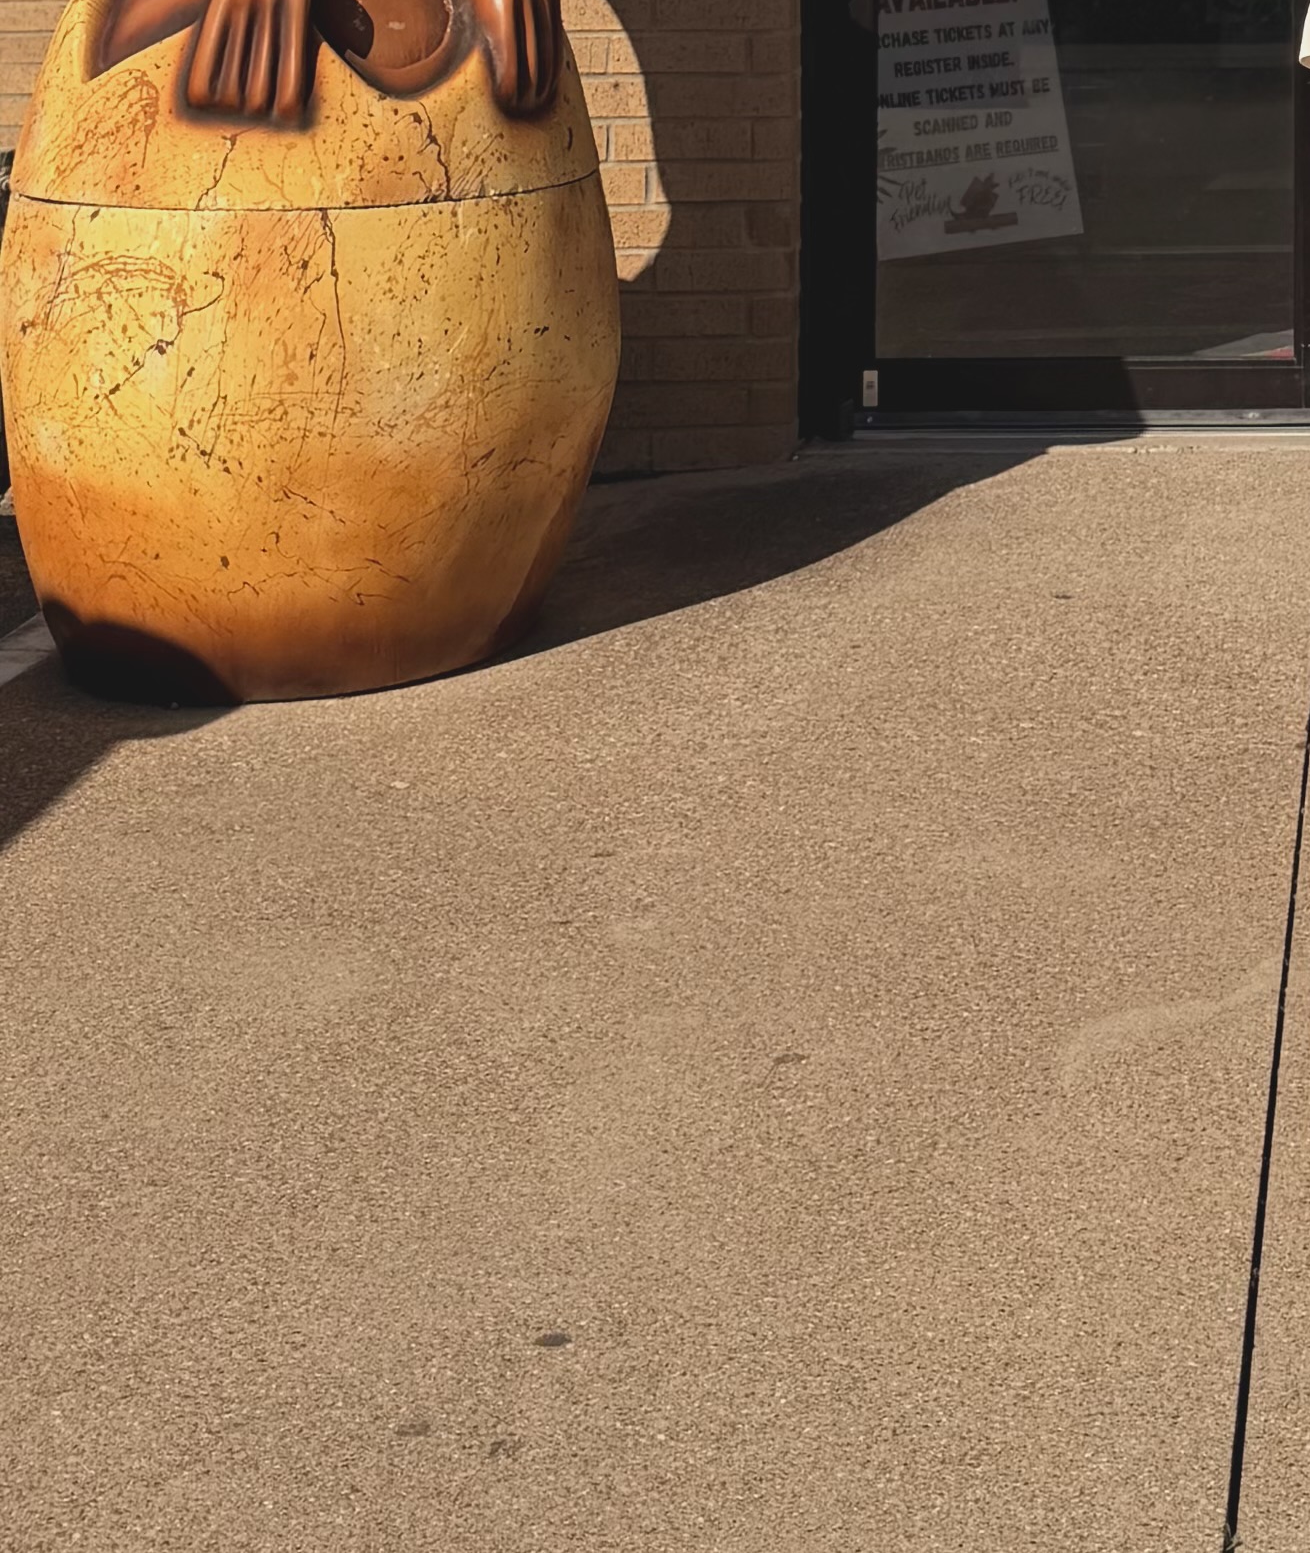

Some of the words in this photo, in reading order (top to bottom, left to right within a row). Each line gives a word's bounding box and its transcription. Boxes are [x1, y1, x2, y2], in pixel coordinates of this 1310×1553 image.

[878, 30, 930, 50] CHASE
[934, 24, 992, 44] TICKETS
[998, 21, 1017, 38] AT
[1022, 19, 1049, 36] ANY
[894, 56, 962, 78] REGISTER
[967, 51, 1015, 72] INSIDE.
[878, 90, 922, 109] NLINE
[926, 84, 984, 105] TICKETS
[989, 80, 1026, 99] MUST
[1032, 77, 1051, 93] BE
[913, 114, 978, 137] SCANNED
[985, 110, 1013, 129] AND
[965, 142, 992, 161] ARE
[996, 135, 1059, 157] REQUIRED
